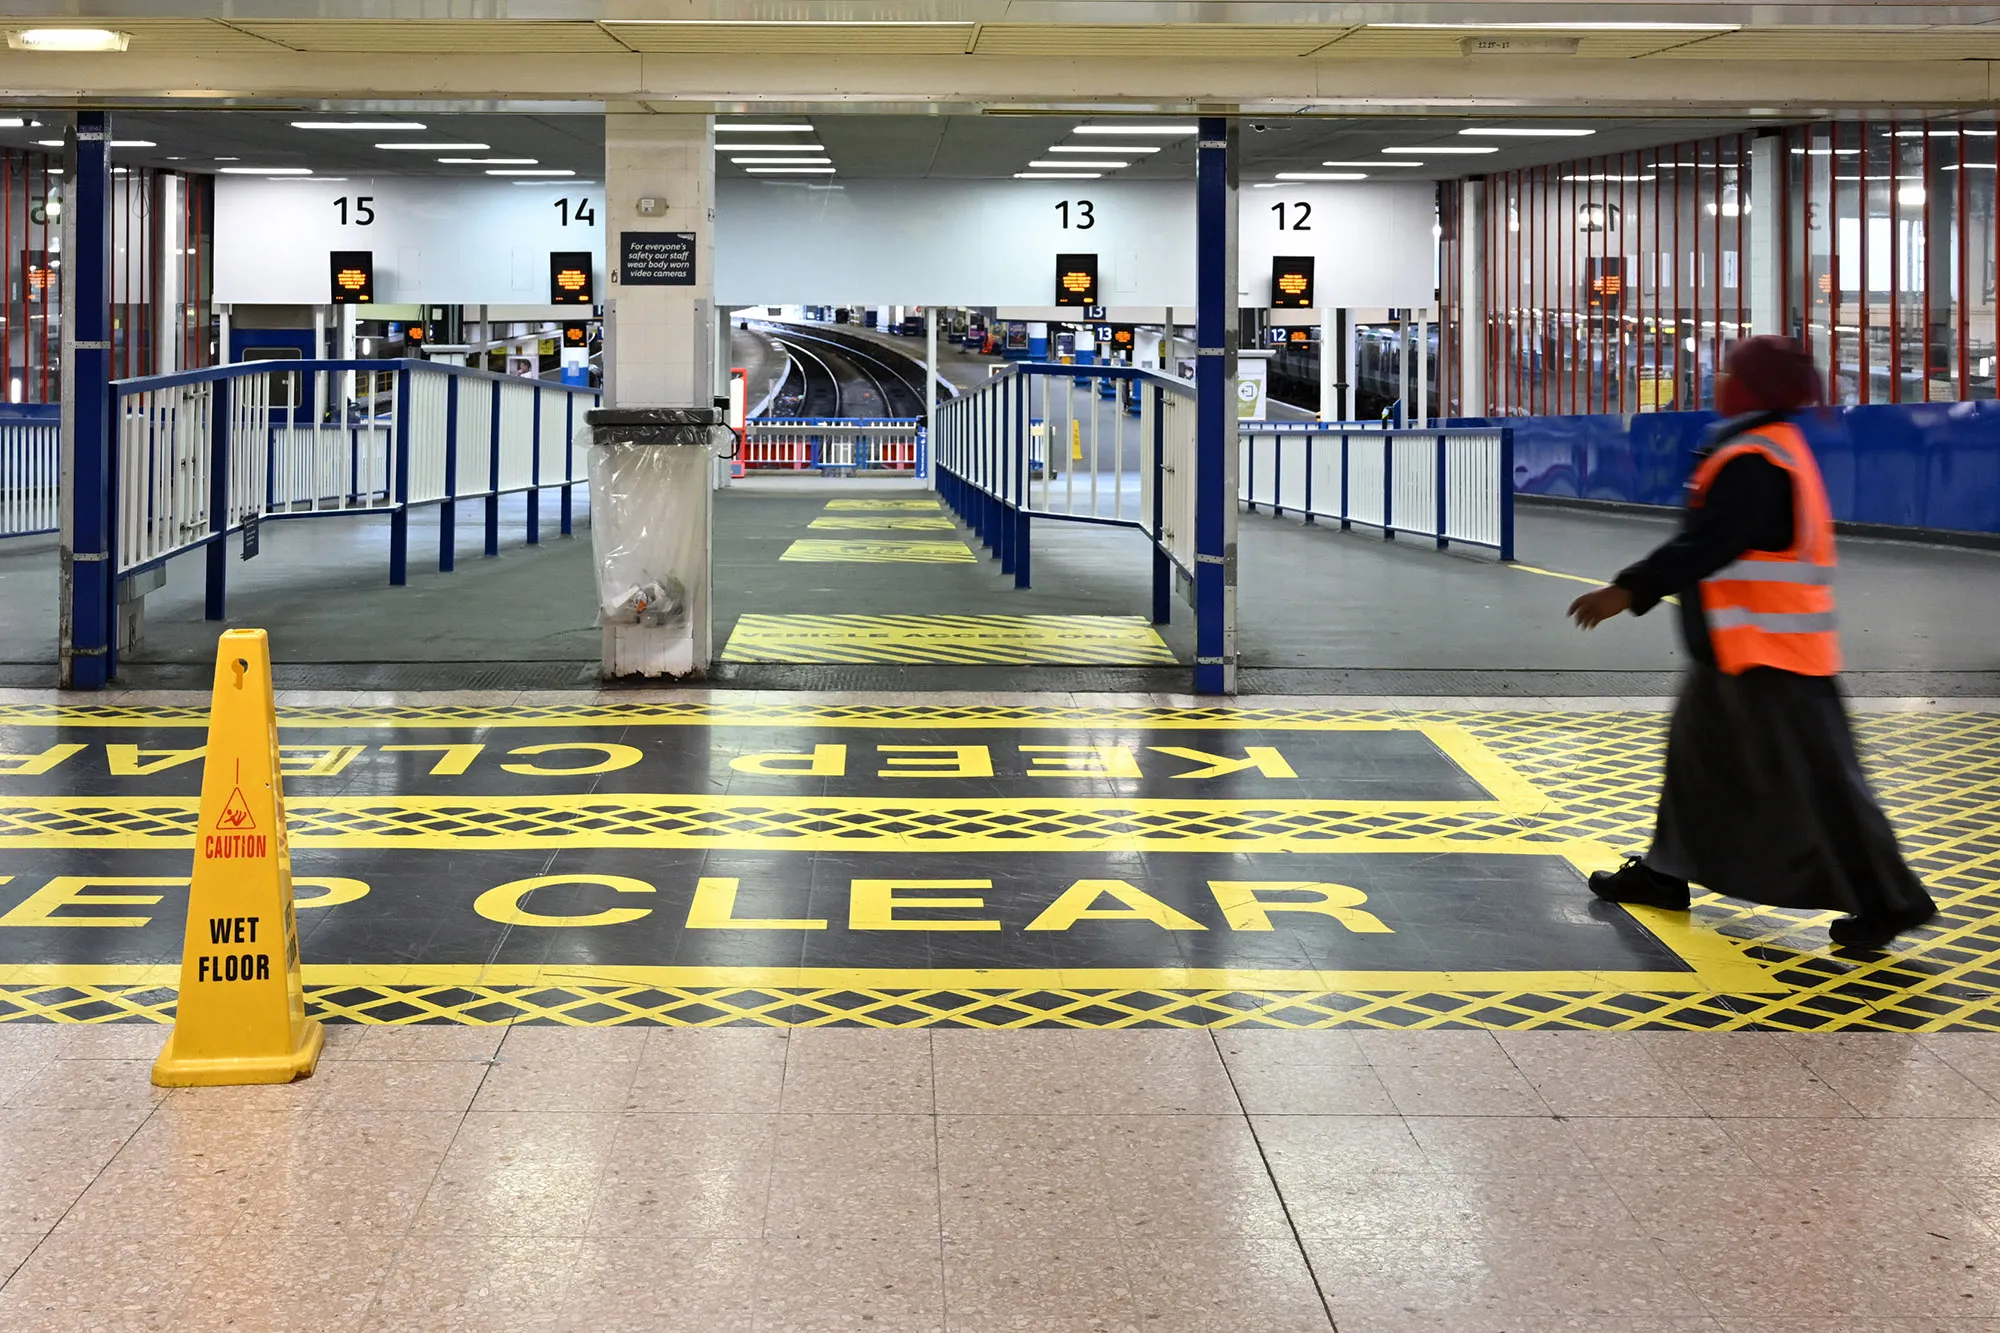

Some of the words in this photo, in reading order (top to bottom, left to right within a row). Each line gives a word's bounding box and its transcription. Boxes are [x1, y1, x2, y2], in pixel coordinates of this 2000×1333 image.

[334, 197, 374, 226] 15
[554, 198, 594, 226] 14
[1055, 200, 1094, 229] 13
[1272, 202, 1312, 230] 12
[628, 251, 653, 260] safety
[670, 251, 690, 260] staff
[630, 242, 644, 250] For
[645, 242, 686, 252] everyone's
[648, 260, 668, 270] body
[1089, 307, 1103, 318] 13
[1097, 327, 1112, 341] 13
[1271, 328, 1287, 342] 12
[729, 744, 1297, 778] KEEP
[205, 835, 266, 859] CAUTION
[473, 874, 1394, 933] CLEAR
[210, 917, 259, 944] WET
[199, 954, 269, 983] FLOOR
